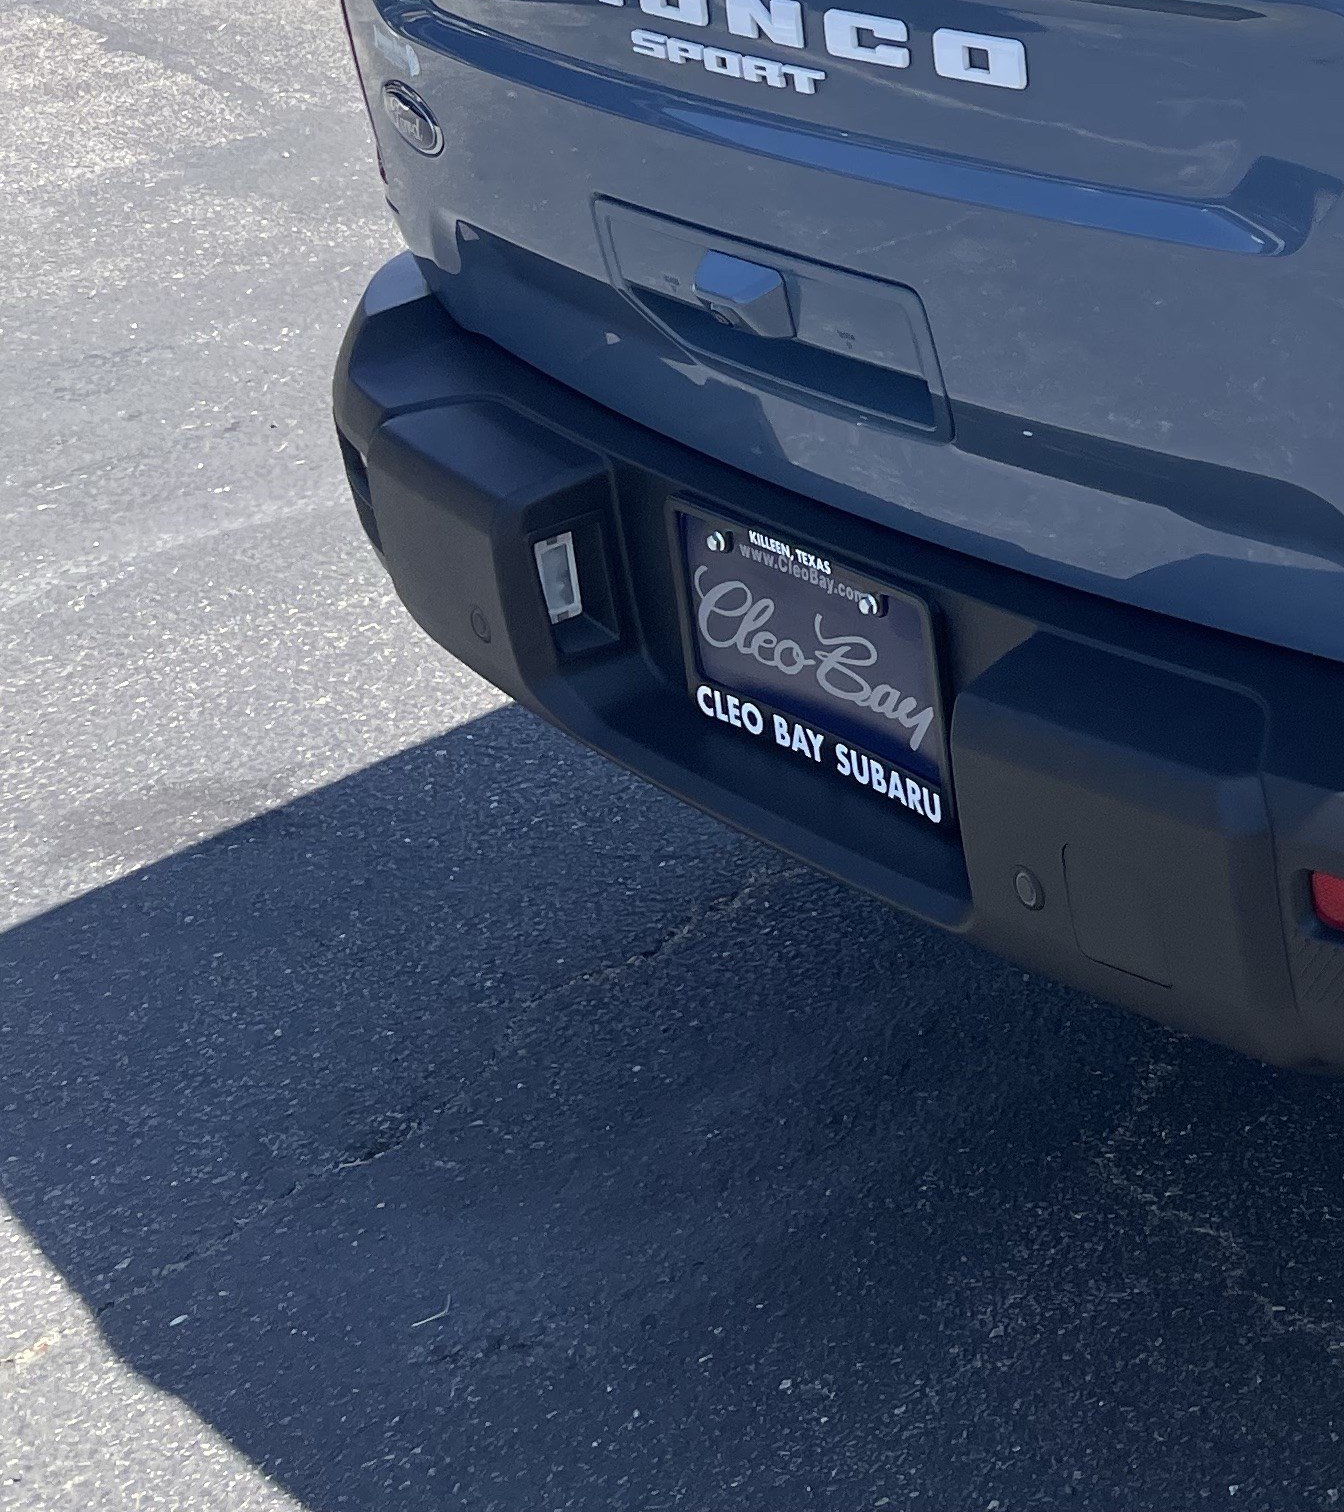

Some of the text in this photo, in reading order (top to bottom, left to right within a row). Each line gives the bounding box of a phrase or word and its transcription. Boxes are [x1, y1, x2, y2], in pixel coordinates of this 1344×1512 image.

[630, 28, 826, 94] SPORT
[748, 529, 831, 575] KILLEEN, TEXAS
[694, 565, 935, 750] Cleo Bay
[696, 685, 942, 824] CLEO BAY SUBARU
